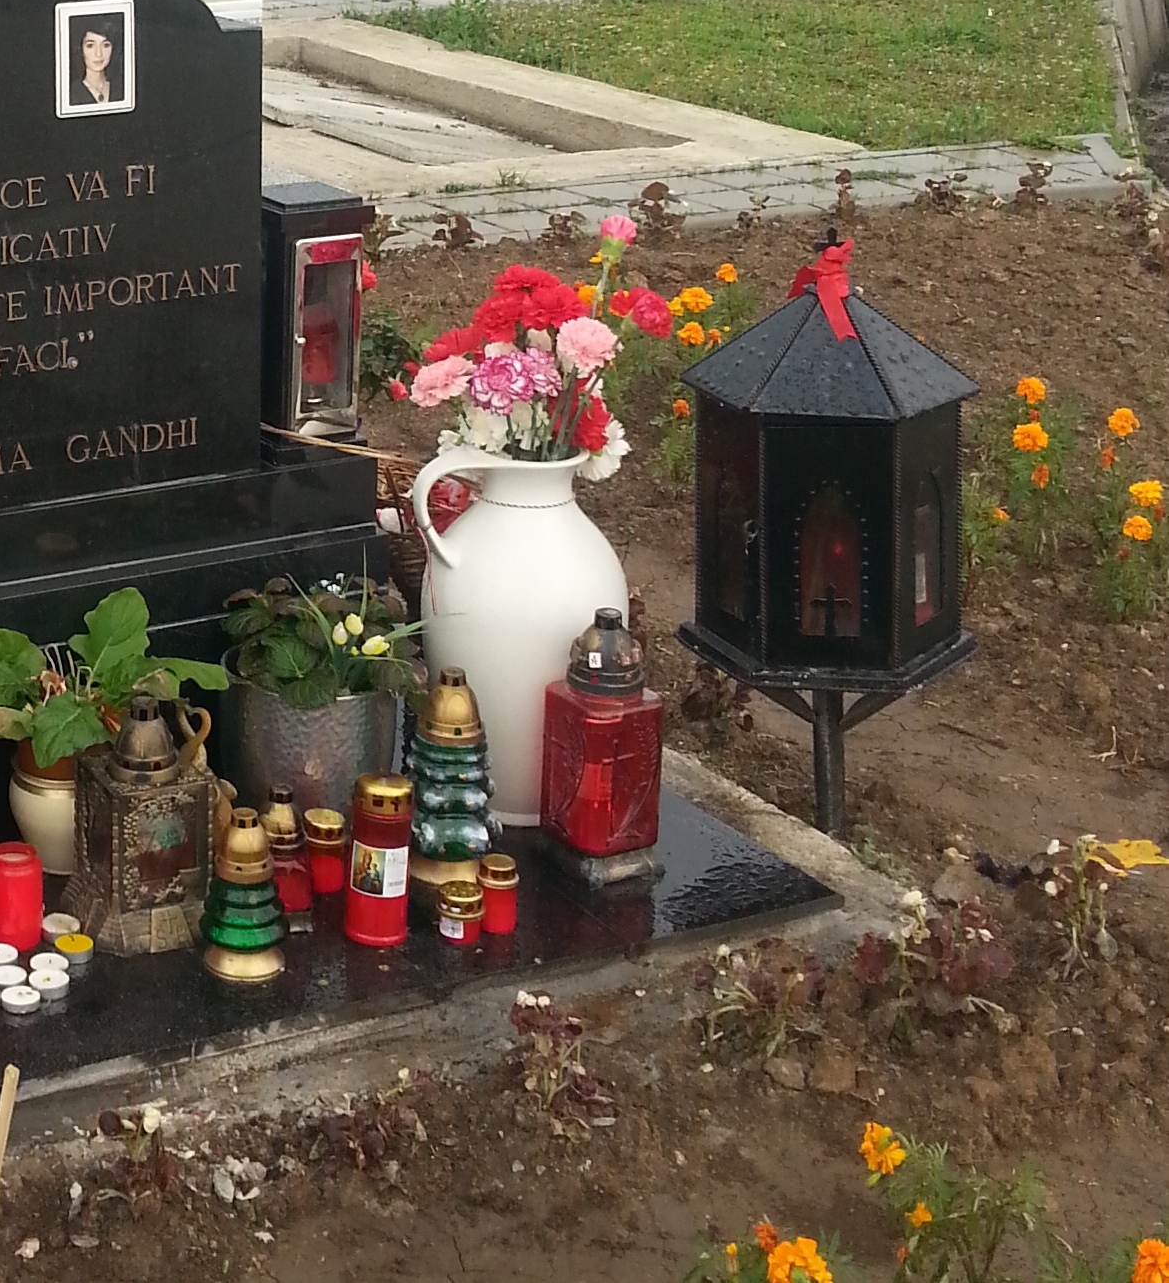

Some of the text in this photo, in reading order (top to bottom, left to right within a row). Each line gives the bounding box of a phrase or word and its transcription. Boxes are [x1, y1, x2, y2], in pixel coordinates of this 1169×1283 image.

[66, 170, 109, 202] VA
[126, 164, 156, 196] FI
[44, 263, 241, 316] IMPORTANT
[66, 416, 197, 464] GANDHI
